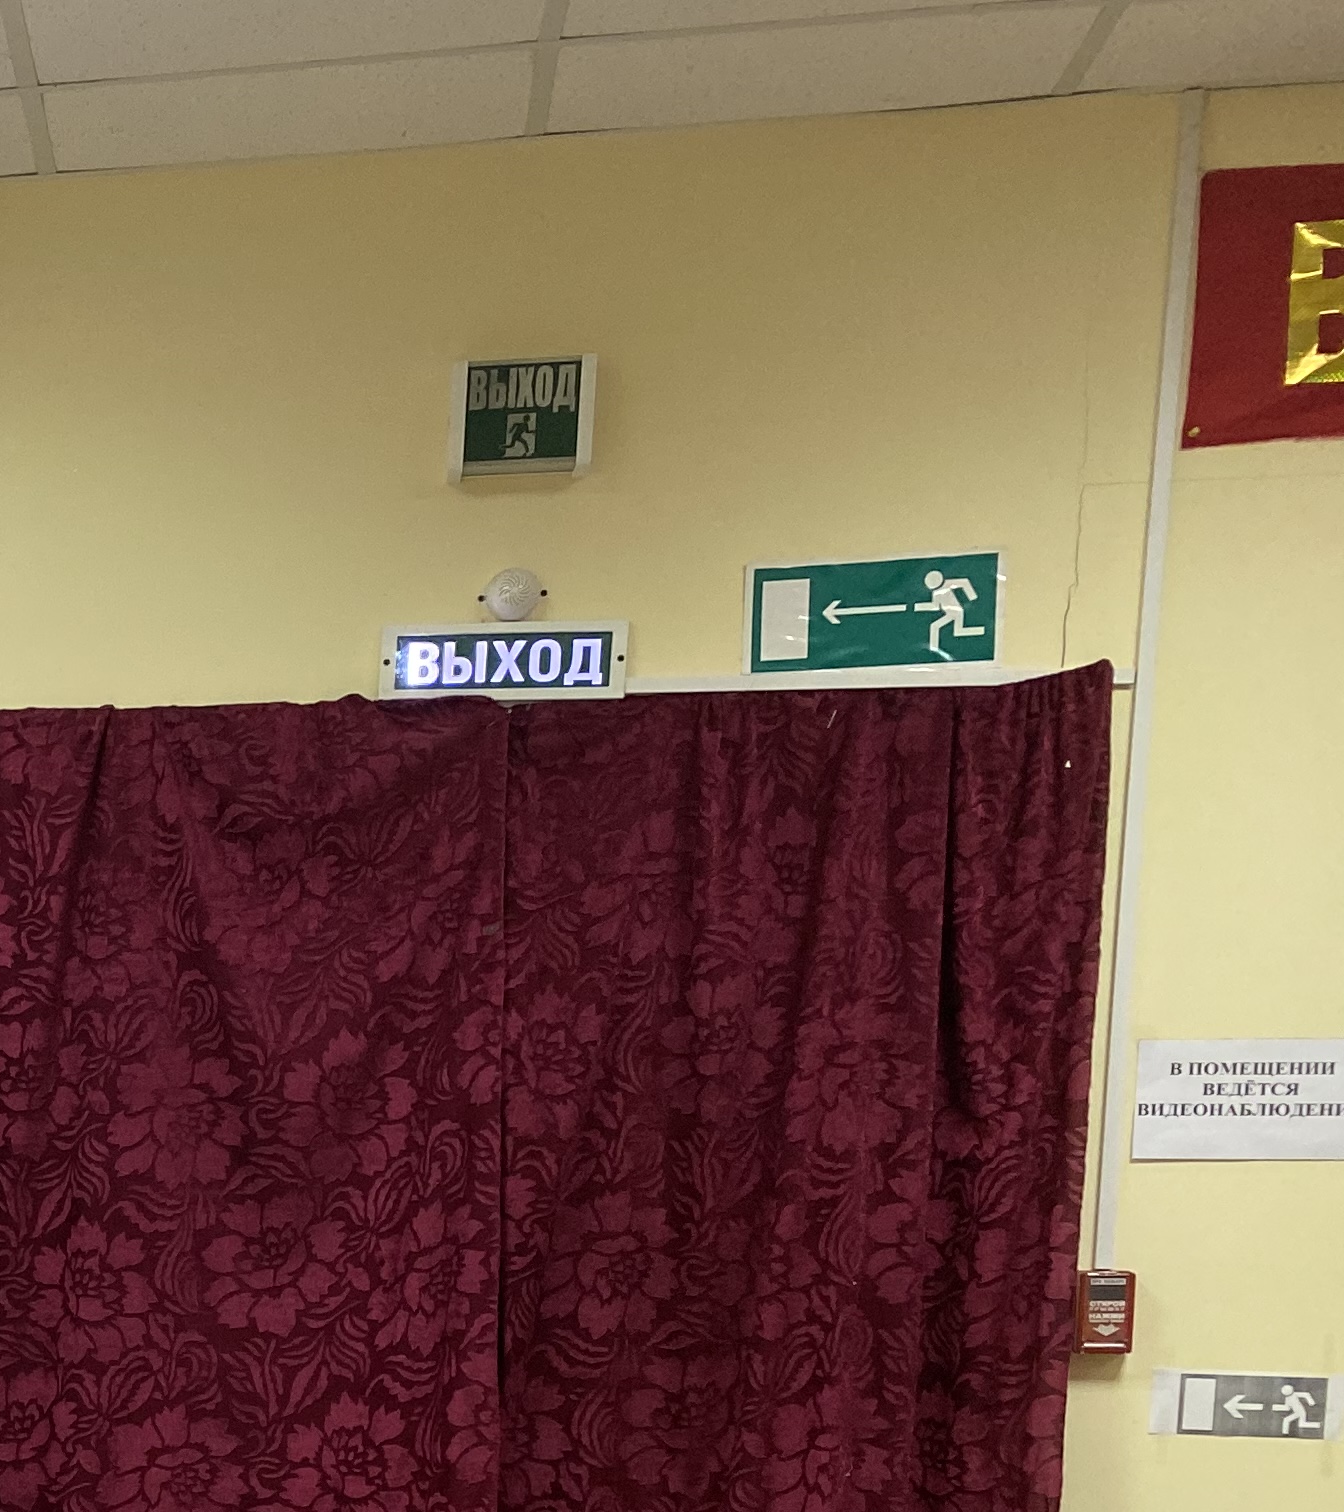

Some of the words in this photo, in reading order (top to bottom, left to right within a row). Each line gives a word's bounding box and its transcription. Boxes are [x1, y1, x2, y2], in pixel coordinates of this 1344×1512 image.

[468, 364, 577, 413] ВЫХОД
[407, 638, 603, 686] ВЫХОД
[1170, 1062, 1182, 1075] В
[1189, 1061, 1336, 1076] ПОМЕЩЕНИИ
[1203, 1079, 1299, 1097] ВЕДЁТСЯ
